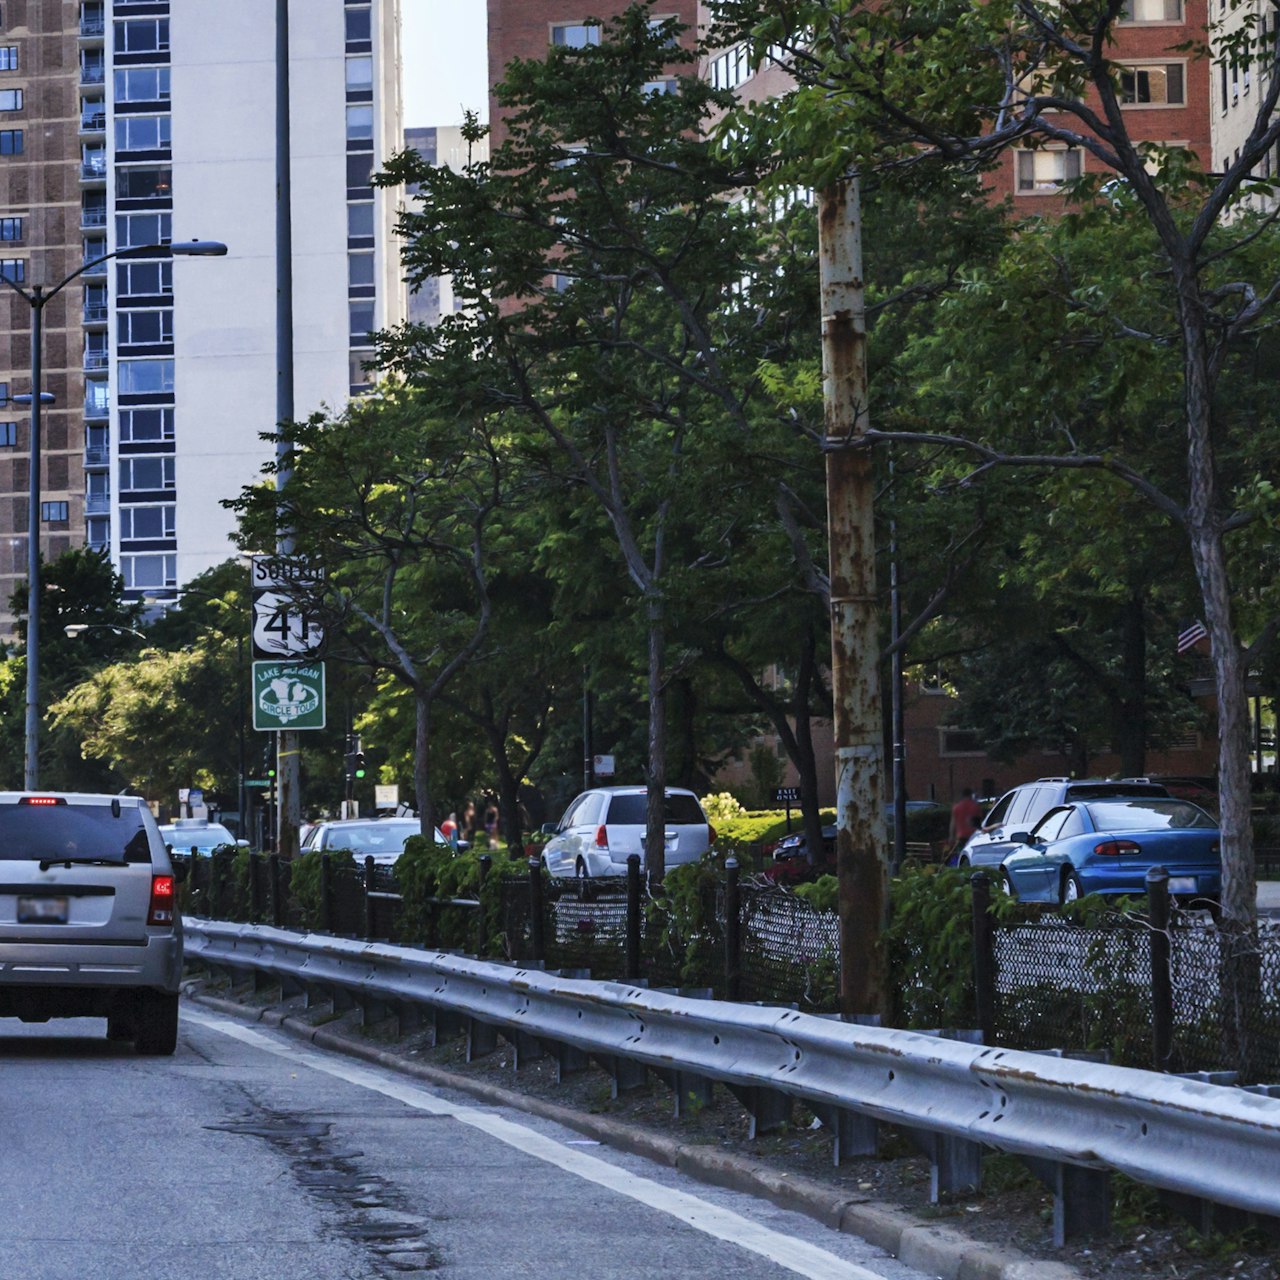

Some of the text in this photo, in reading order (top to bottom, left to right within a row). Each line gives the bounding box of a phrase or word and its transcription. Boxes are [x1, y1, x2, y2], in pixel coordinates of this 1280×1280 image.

[263, 607, 309, 641] 41
[257, 667, 280, 681] LAKE
[262, 700, 316, 715] CIRCLE TOUR
